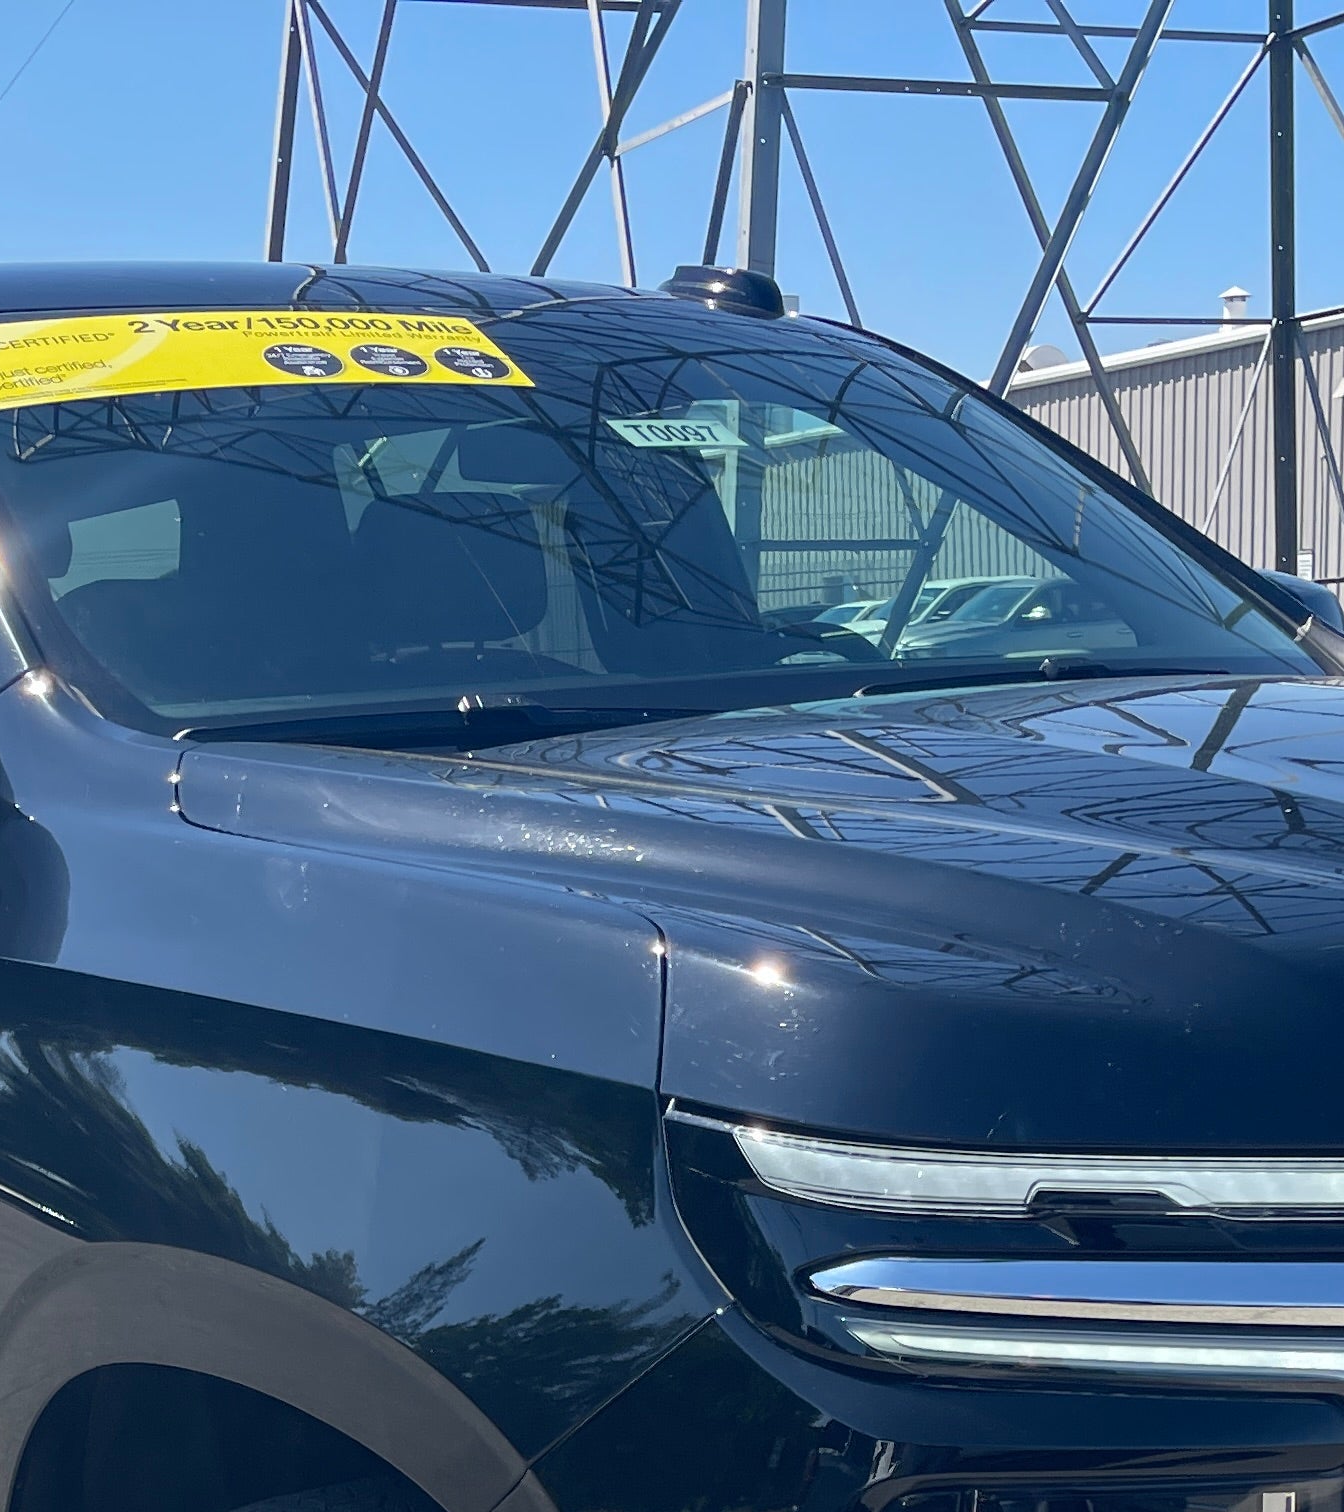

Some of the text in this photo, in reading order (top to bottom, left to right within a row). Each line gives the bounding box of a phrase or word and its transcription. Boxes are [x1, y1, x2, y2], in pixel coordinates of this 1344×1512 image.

[128, 320, 155, 334] 2
[394, 318, 473, 335] Mile
[243, 330, 481, 344] Powertrain Limited Warranty
[623, 424, 720, 442] T0097
